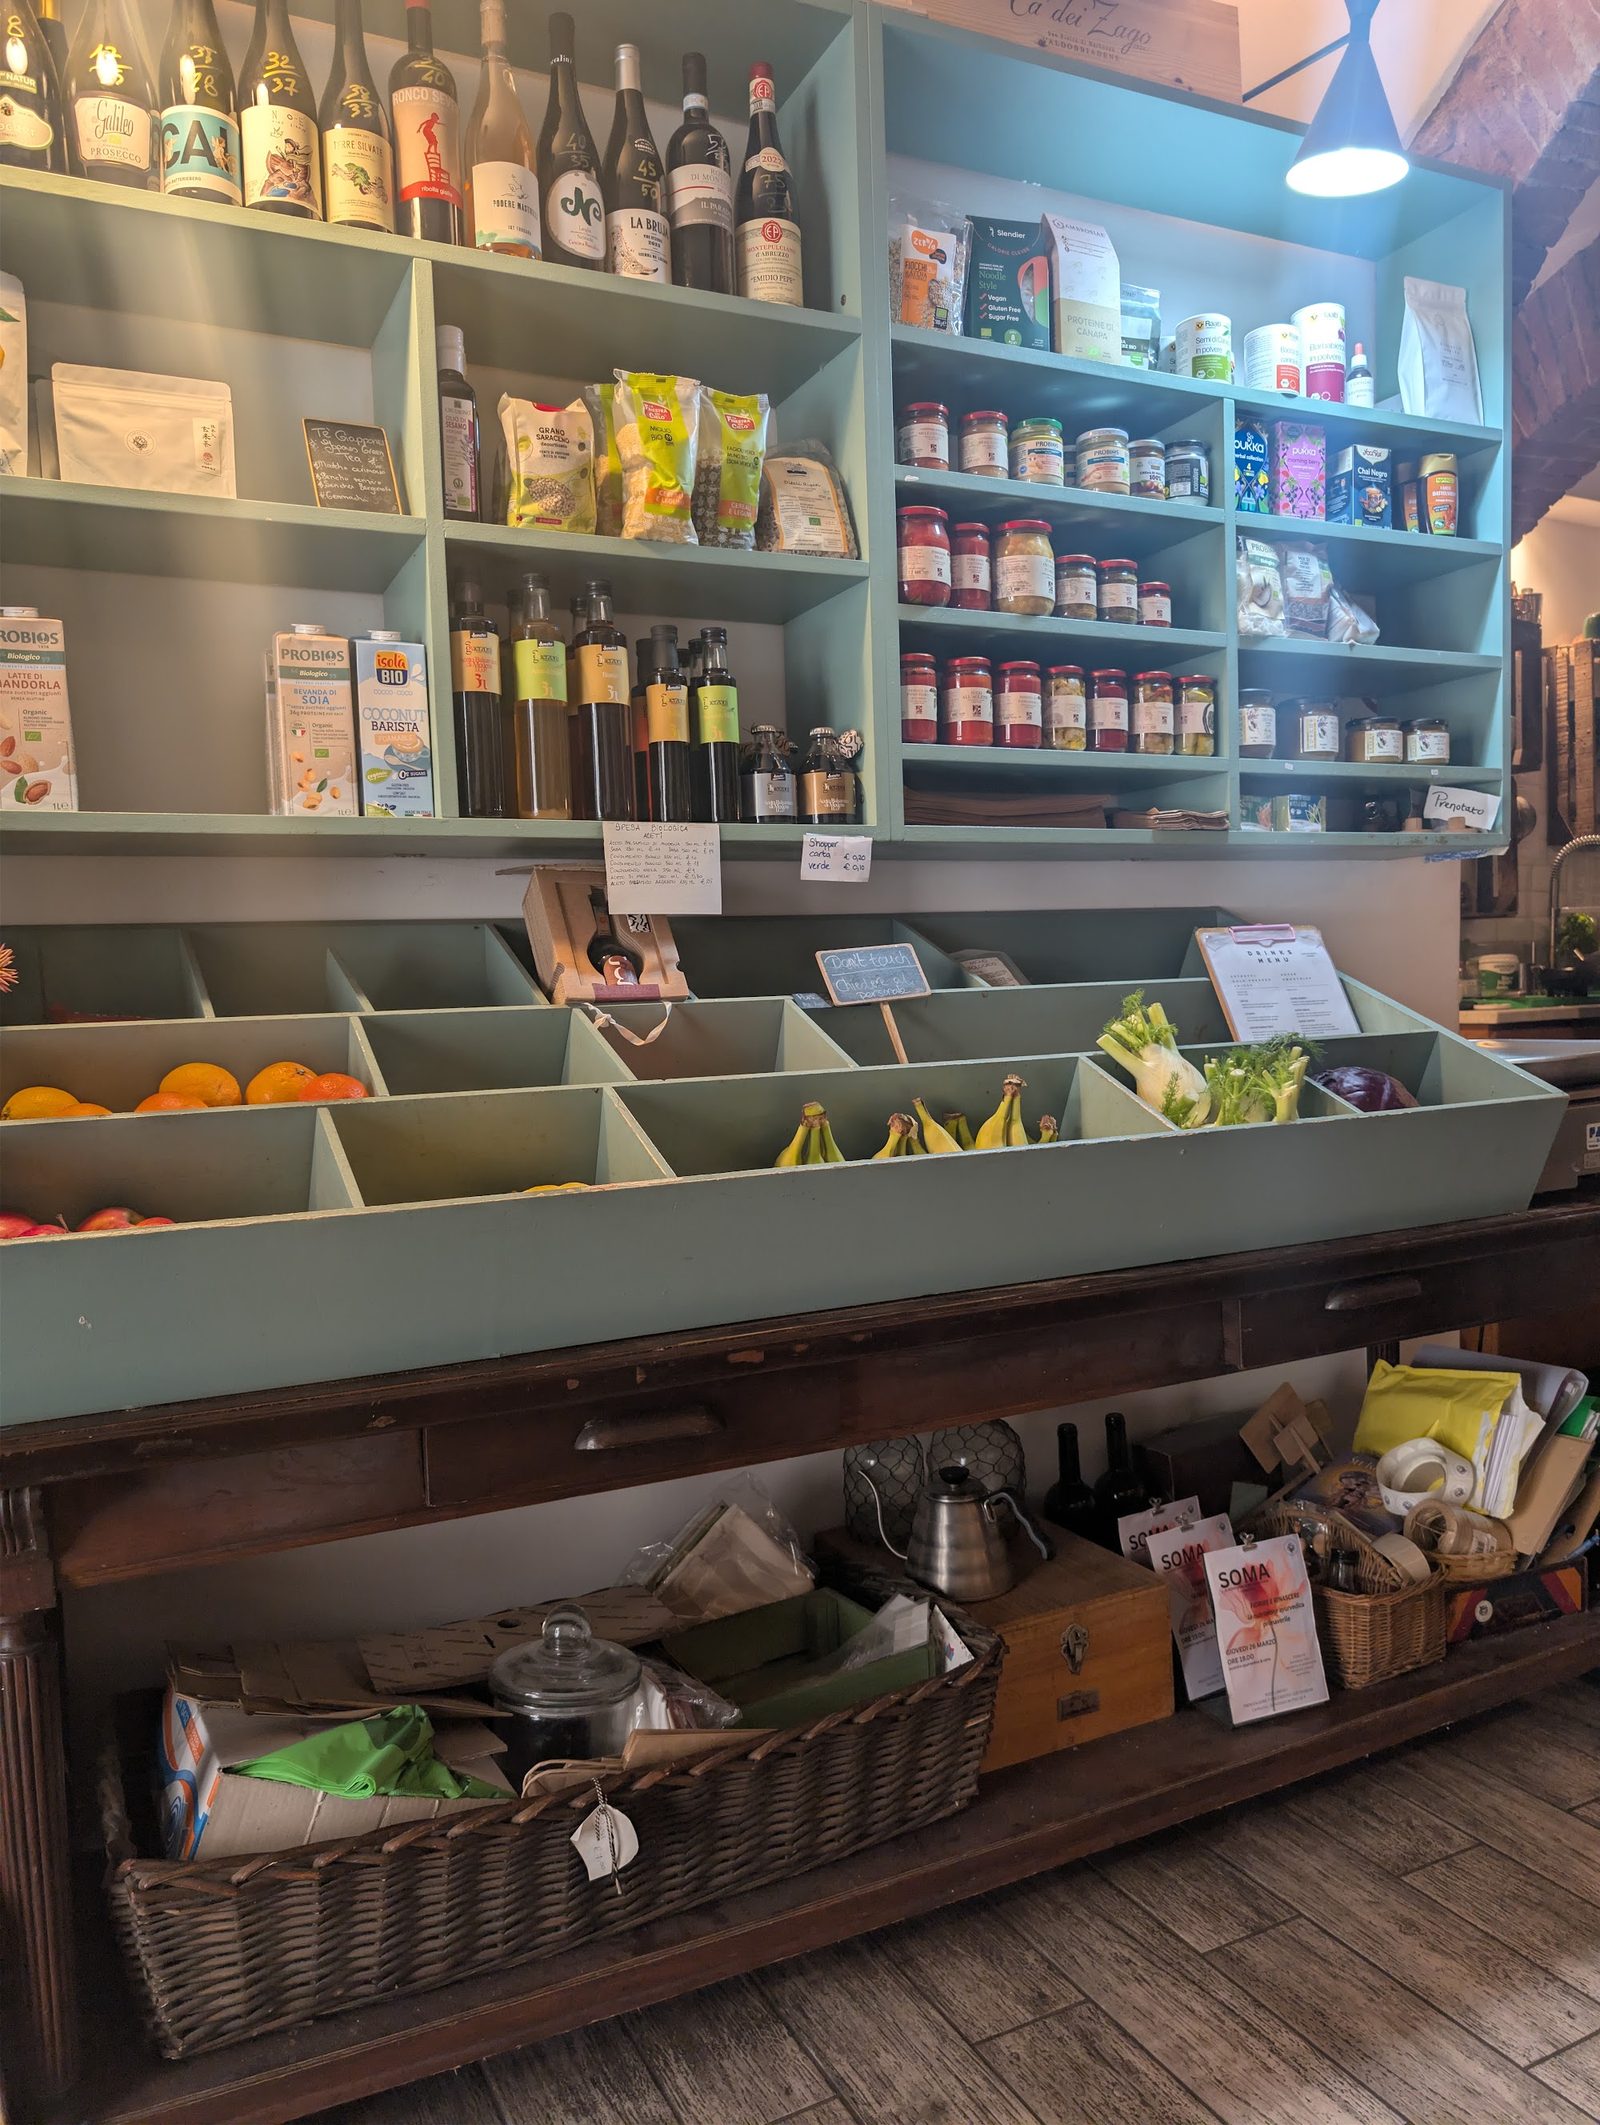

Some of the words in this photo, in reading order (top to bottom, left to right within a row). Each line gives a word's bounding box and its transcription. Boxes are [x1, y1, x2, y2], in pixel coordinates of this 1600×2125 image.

[1088, 0, 1152, 55] Zago
[266, 51, 296, 70] 32
[271, 77, 299, 97] 37
[392, 88, 429, 106] RONCO
[348, 103, 373, 118] 33
[95, 99, 134, 139] Galileo
[90, 146, 142, 164] PROSECCO
[638, 159, 657, 177] 45
[641, 183, 659, 200] 50
[630, 216, 644, 230] LA
[996, 229, 1026, 239] Slendier
[979, 271, 1007, 281] Noodle
[979, 281, 998, 291] Style
[988, 294, 1007, 302] Vegan
[988, 305, 1007, 313] Gluten
[988, 313, 1006, 322] Sugar
[445, 421, 467, 431] SESAMO
[538, 427, 566, 437] GRANO
[535, 433, 570, 444] SARACENO
[1292, 447, 1317, 456] pukka
[1357, 466, 1371, 475] Chai
[1371, 468, 1388, 479] Negro
[0, 630, 59, 646] ROBIOS
[7, 652, 41, 662] Biologico
[281, 648, 345, 662] PROBIOS
[8, 672, 32, 680] LATTE
[299, 670, 329, 678] Biologico
[381, 670, 404, 684] BIO
[293, 688, 327, 696] BEVANDA
[302, 695, 330, 705] SOIA
[22, 709, 48, 717] Organic
[362, 706, 426, 722] COCONUT
[312, 722, 333, 730] Organic
[371, 721, 420, 733] BARISTA
[1431, 790, 1485, 816] Prenotato
[615, 823, 641, 832] SPESA
[651, 822, 689, 832] BIOLOGICA
[808, 837, 839, 851] Shopper
[808, 850, 831, 858] carta
[843, 853, 850, 861] €
[852, 854, 866, 862] 0,20
[808, 860, 831, 870] verde
[843, 862, 850, 871] €
[1247, 949, 1293, 957] DRINKS
[868, 950, 911, 968] touch
[1161, 1543, 1207, 1571] SOMA
[1218, 1563, 1271, 1589] SOMA
[1256, 1639, 1277, 1649] MARZO
[1227, 1656, 1238, 1665] ORE
